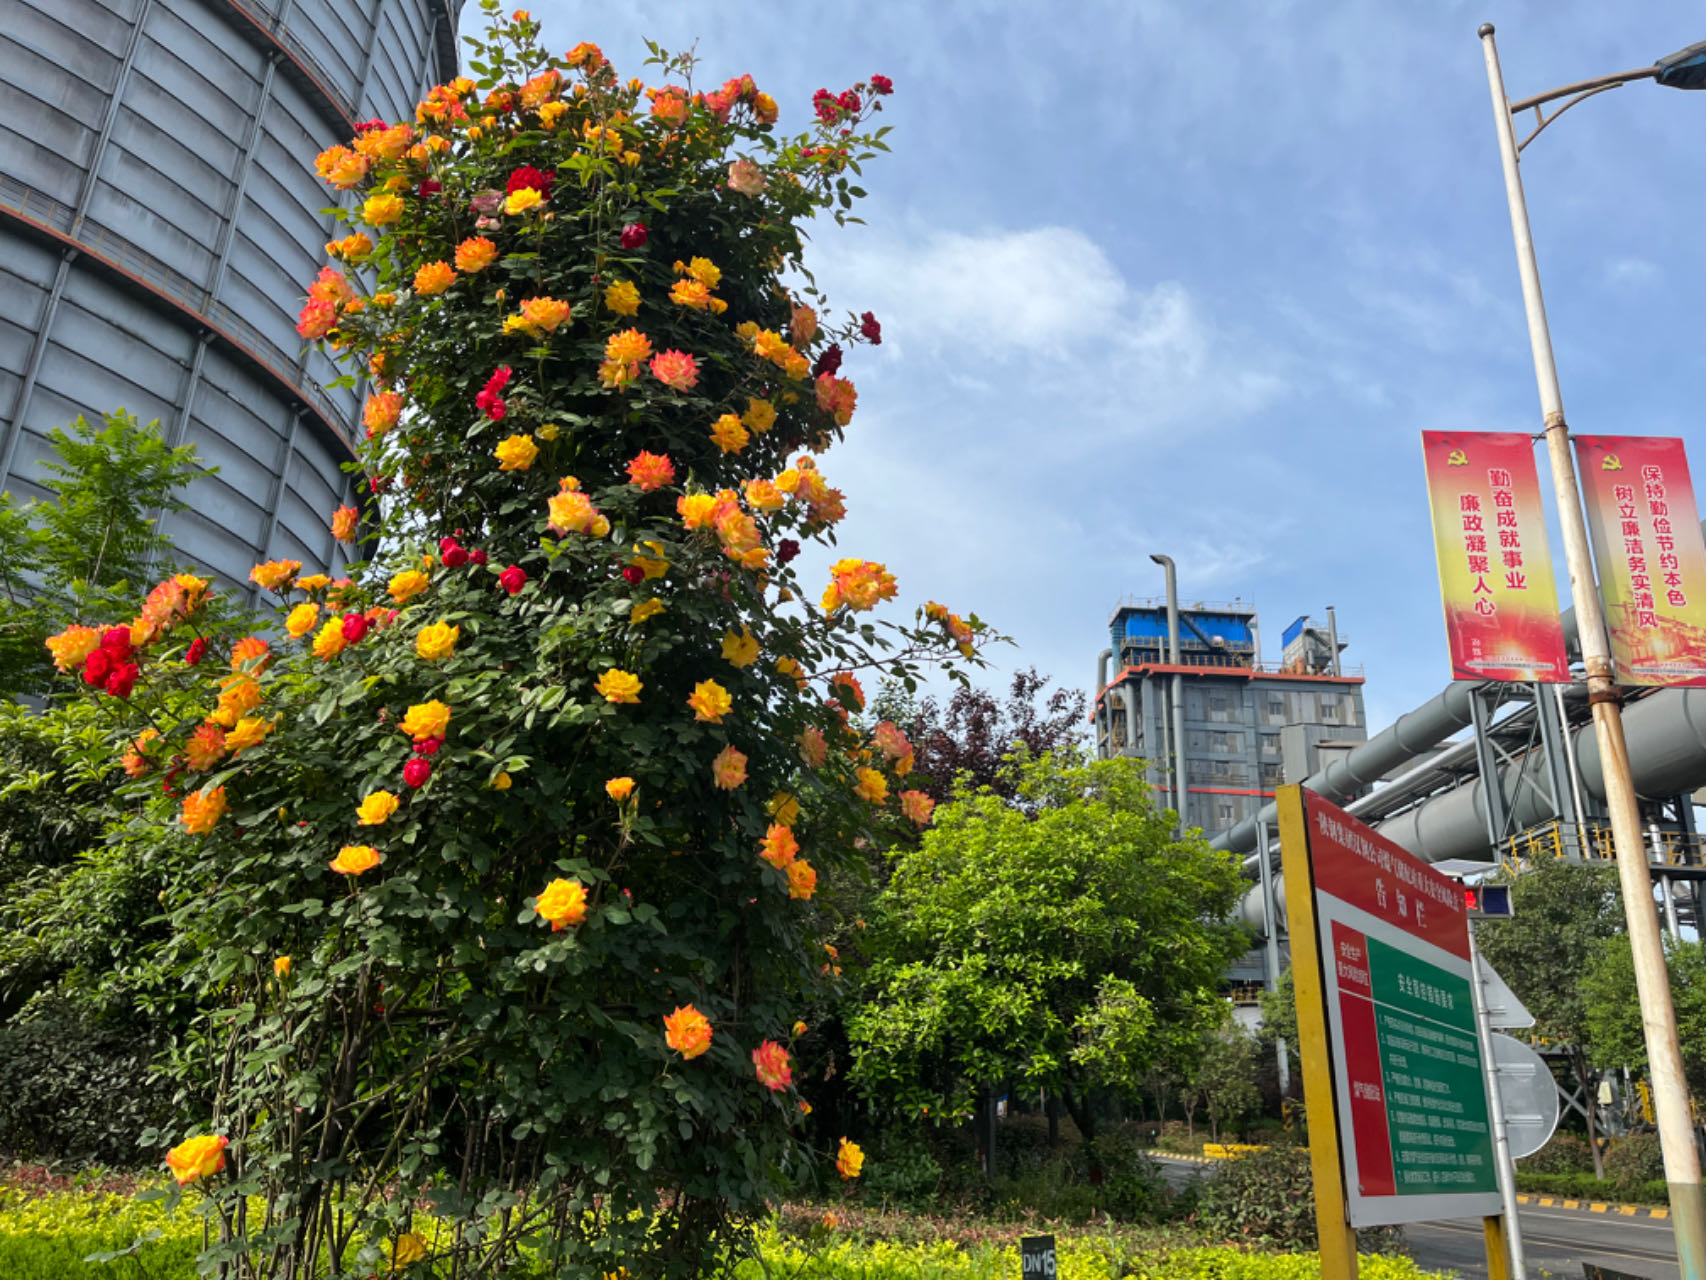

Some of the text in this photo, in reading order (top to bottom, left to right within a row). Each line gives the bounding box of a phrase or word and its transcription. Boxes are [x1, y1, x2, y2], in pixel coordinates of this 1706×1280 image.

[1460, 493, 1496, 618] 廉政凝聚人心
[1488, 468, 1527, 591] 勤奋成就事业
[1614, 485, 1659, 628] 树立廉洁务实清风
[1641, 464, 1687, 607] 保持勤俭节约本色
[1375, 878, 1427, 928] 告知栏
[1023, 1249, 1057, 1276] DN15
